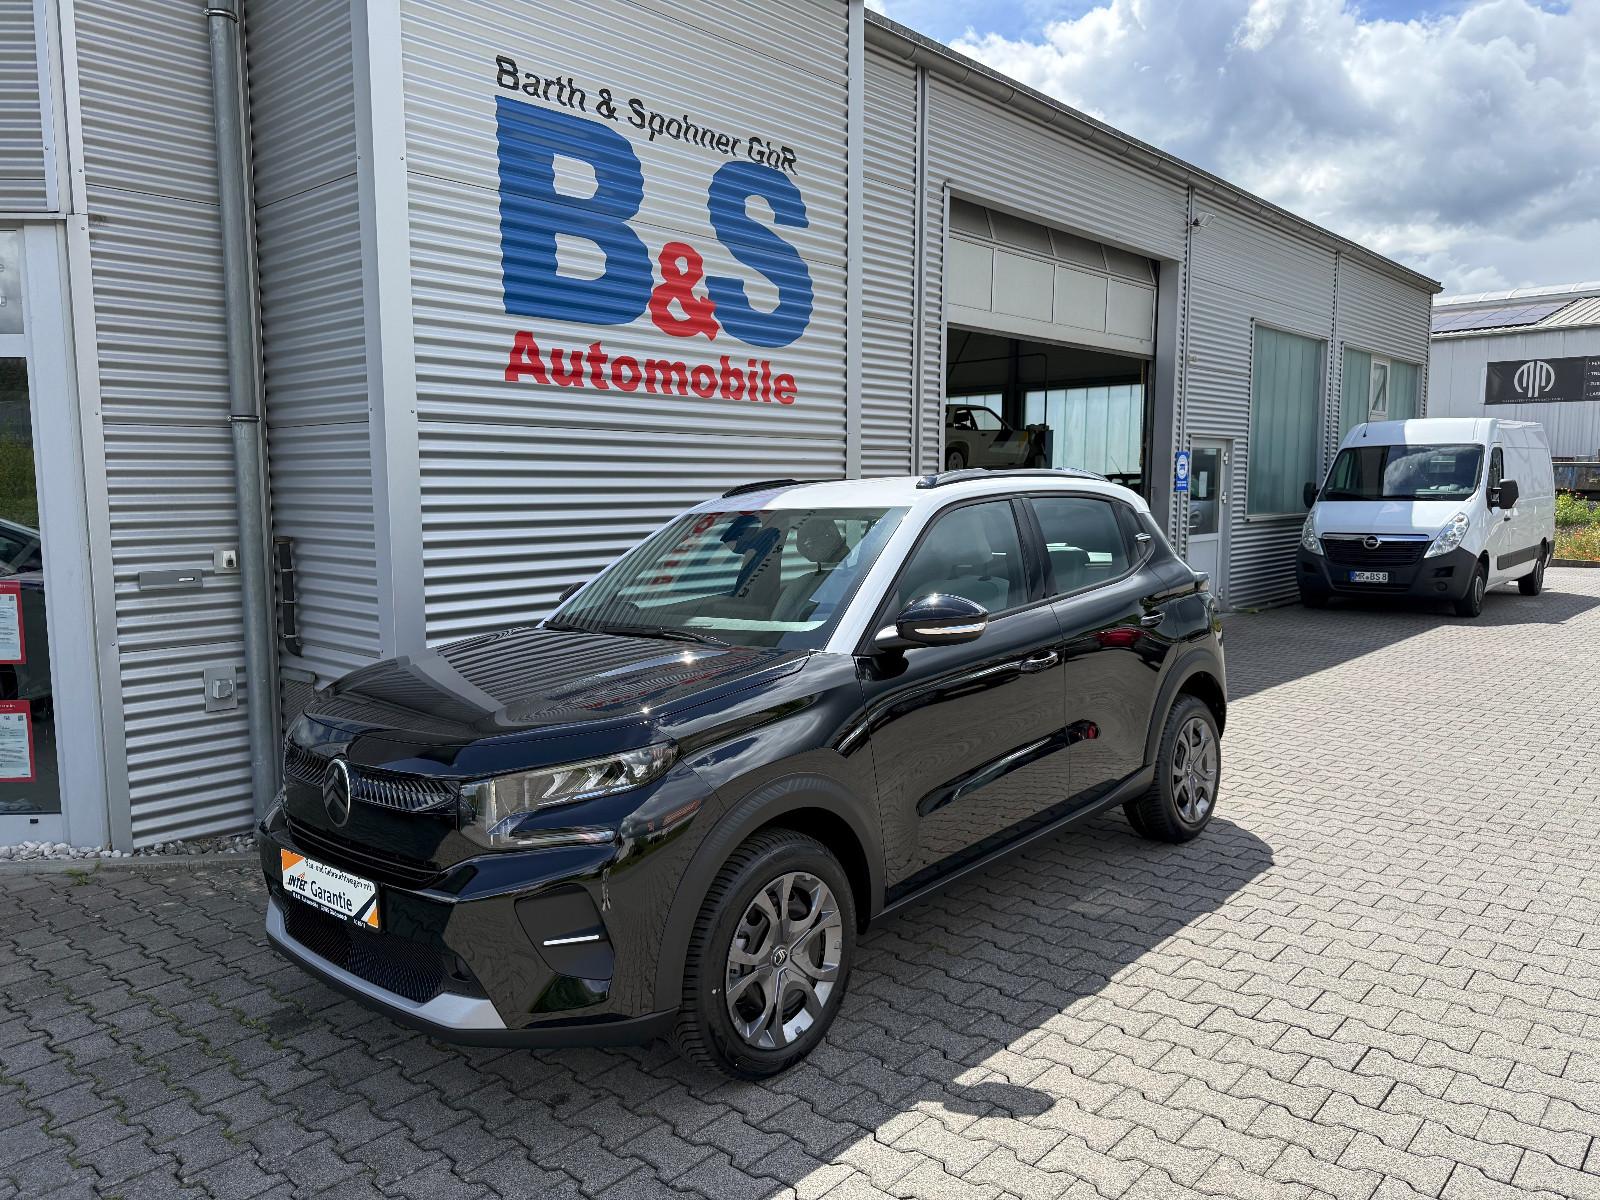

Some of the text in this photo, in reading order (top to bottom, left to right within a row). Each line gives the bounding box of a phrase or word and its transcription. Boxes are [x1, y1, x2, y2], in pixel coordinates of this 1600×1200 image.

[496, 54, 798, 176] Barth & Spohner GbR
[494, 94, 814, 348] B&S
[504, 330, 798, 405] Automobile
[310, 880, 353, 912] Garantie
